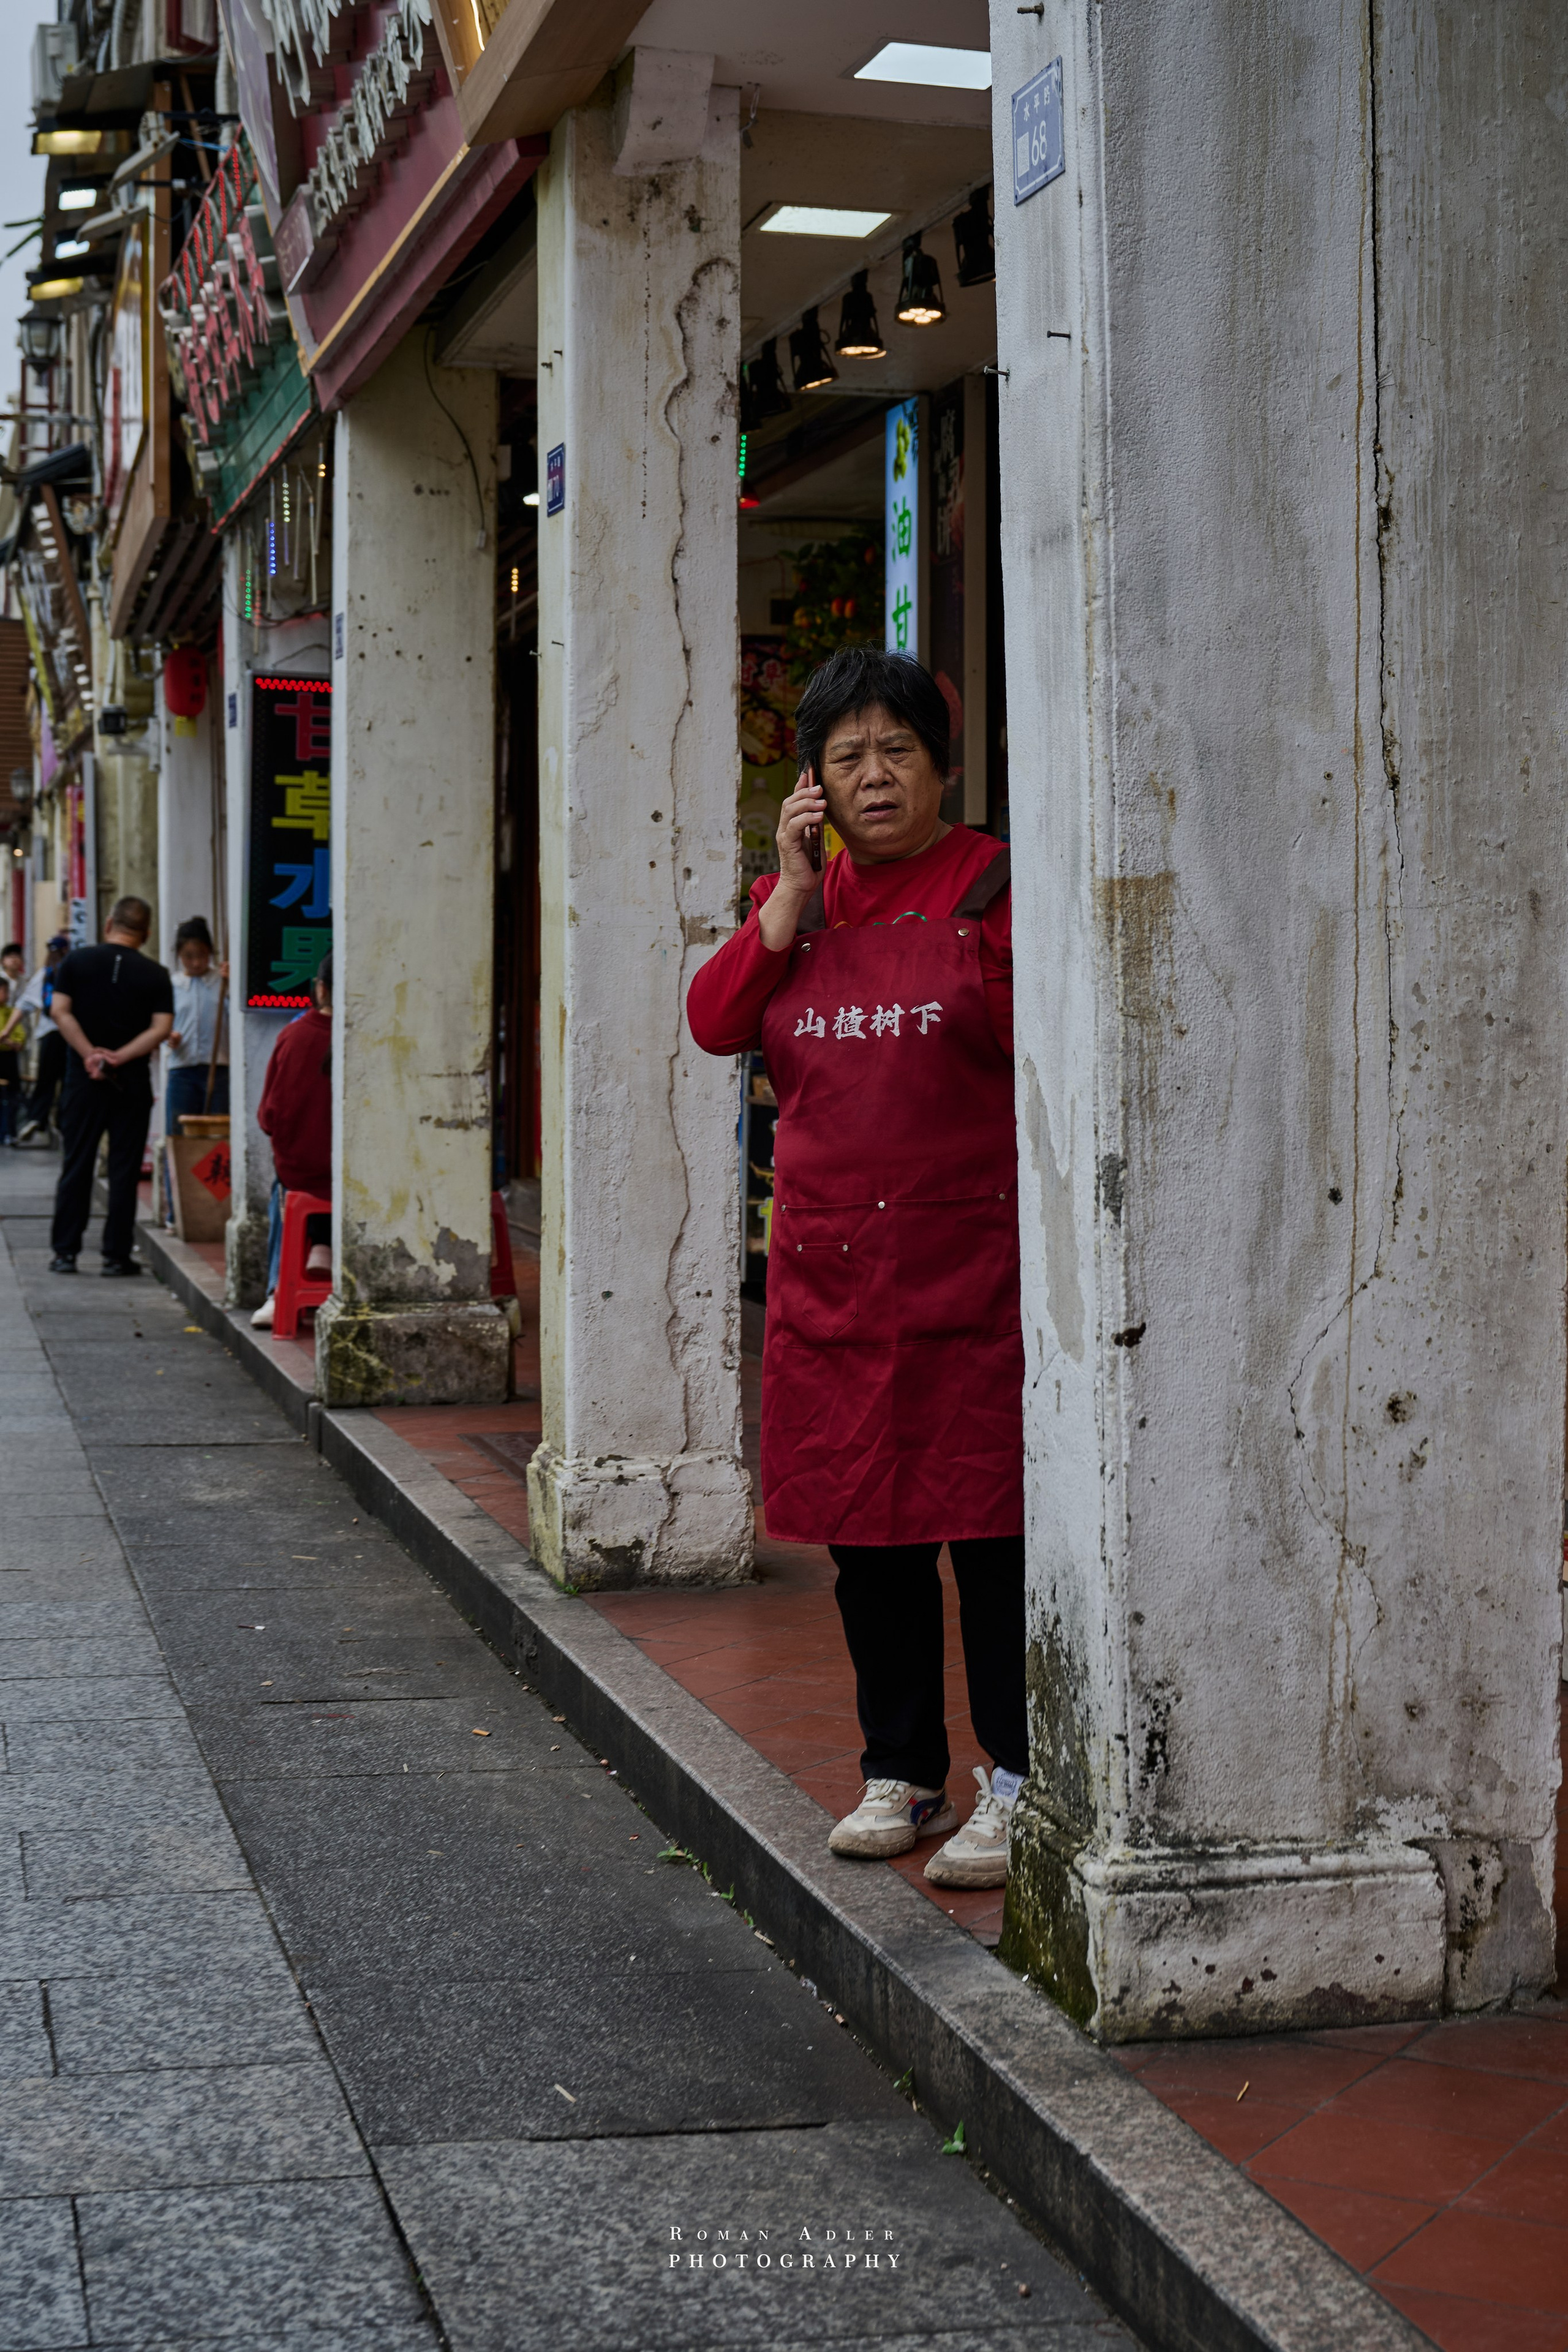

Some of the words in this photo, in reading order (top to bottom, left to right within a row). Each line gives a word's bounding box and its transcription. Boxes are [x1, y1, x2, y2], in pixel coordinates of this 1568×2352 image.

[1031, 120, 1047, 166] 68
[794, 1001, 943, 1040] 山楂树下
